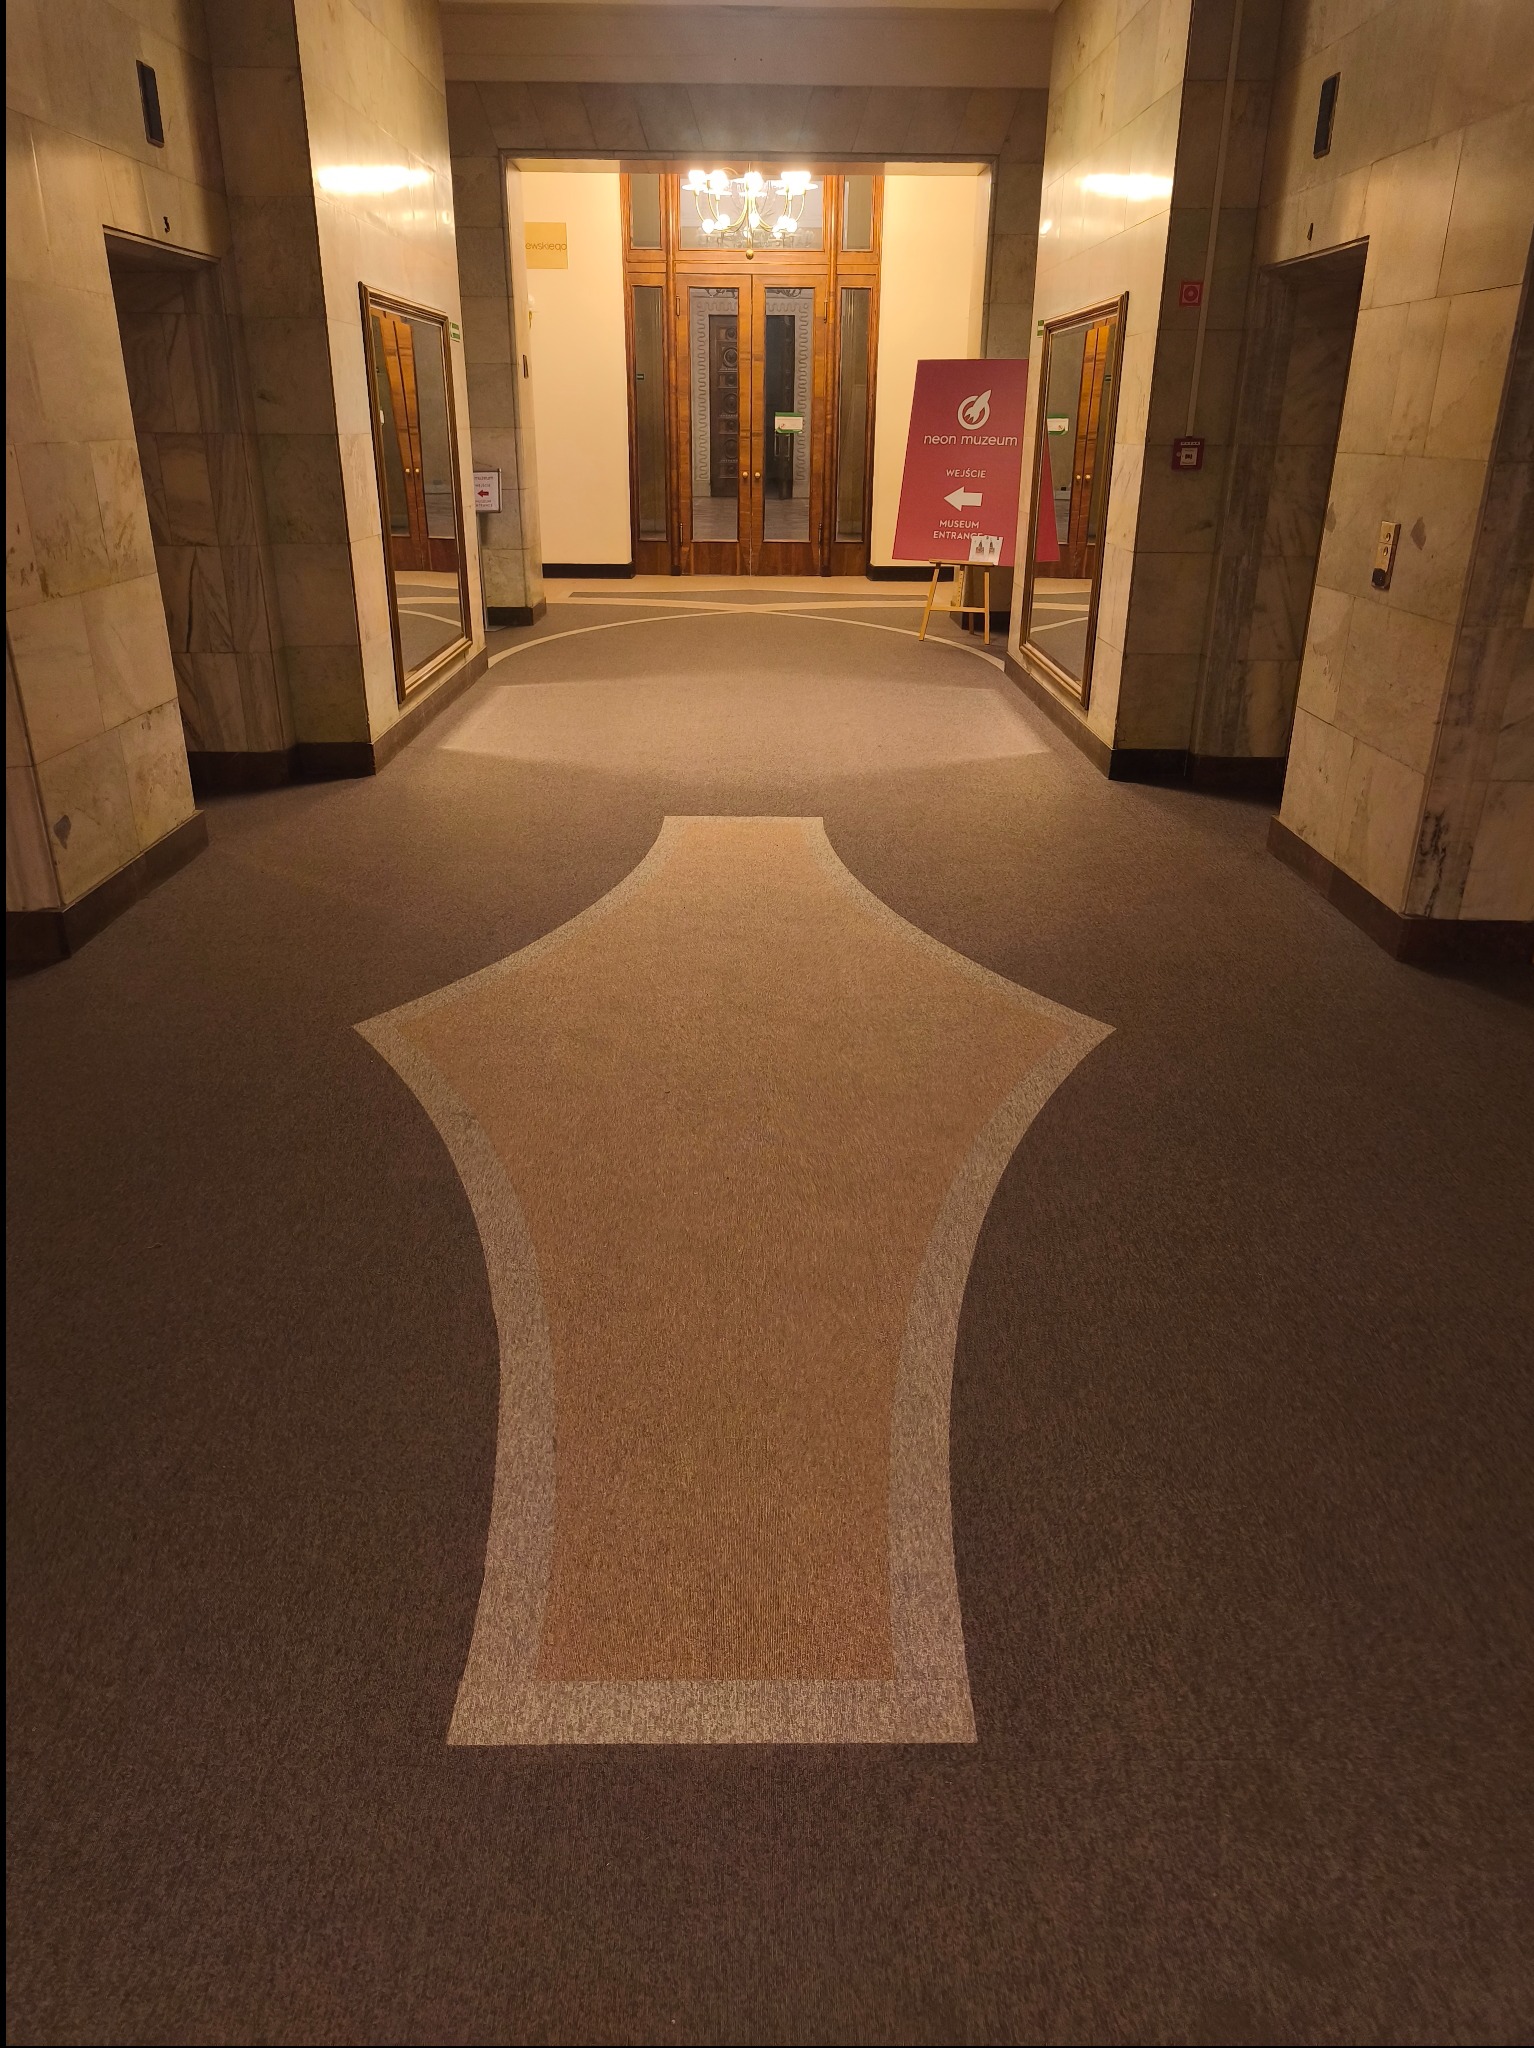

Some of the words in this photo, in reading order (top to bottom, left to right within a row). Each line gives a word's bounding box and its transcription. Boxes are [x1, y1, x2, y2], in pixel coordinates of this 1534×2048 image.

[924, 434, 957, 445] neon
[960, 434, 1018, 446] muzeum
[946, 468, 986, 478] WEJŚCIE
[939, 520, 980, 529] MUSEUM
